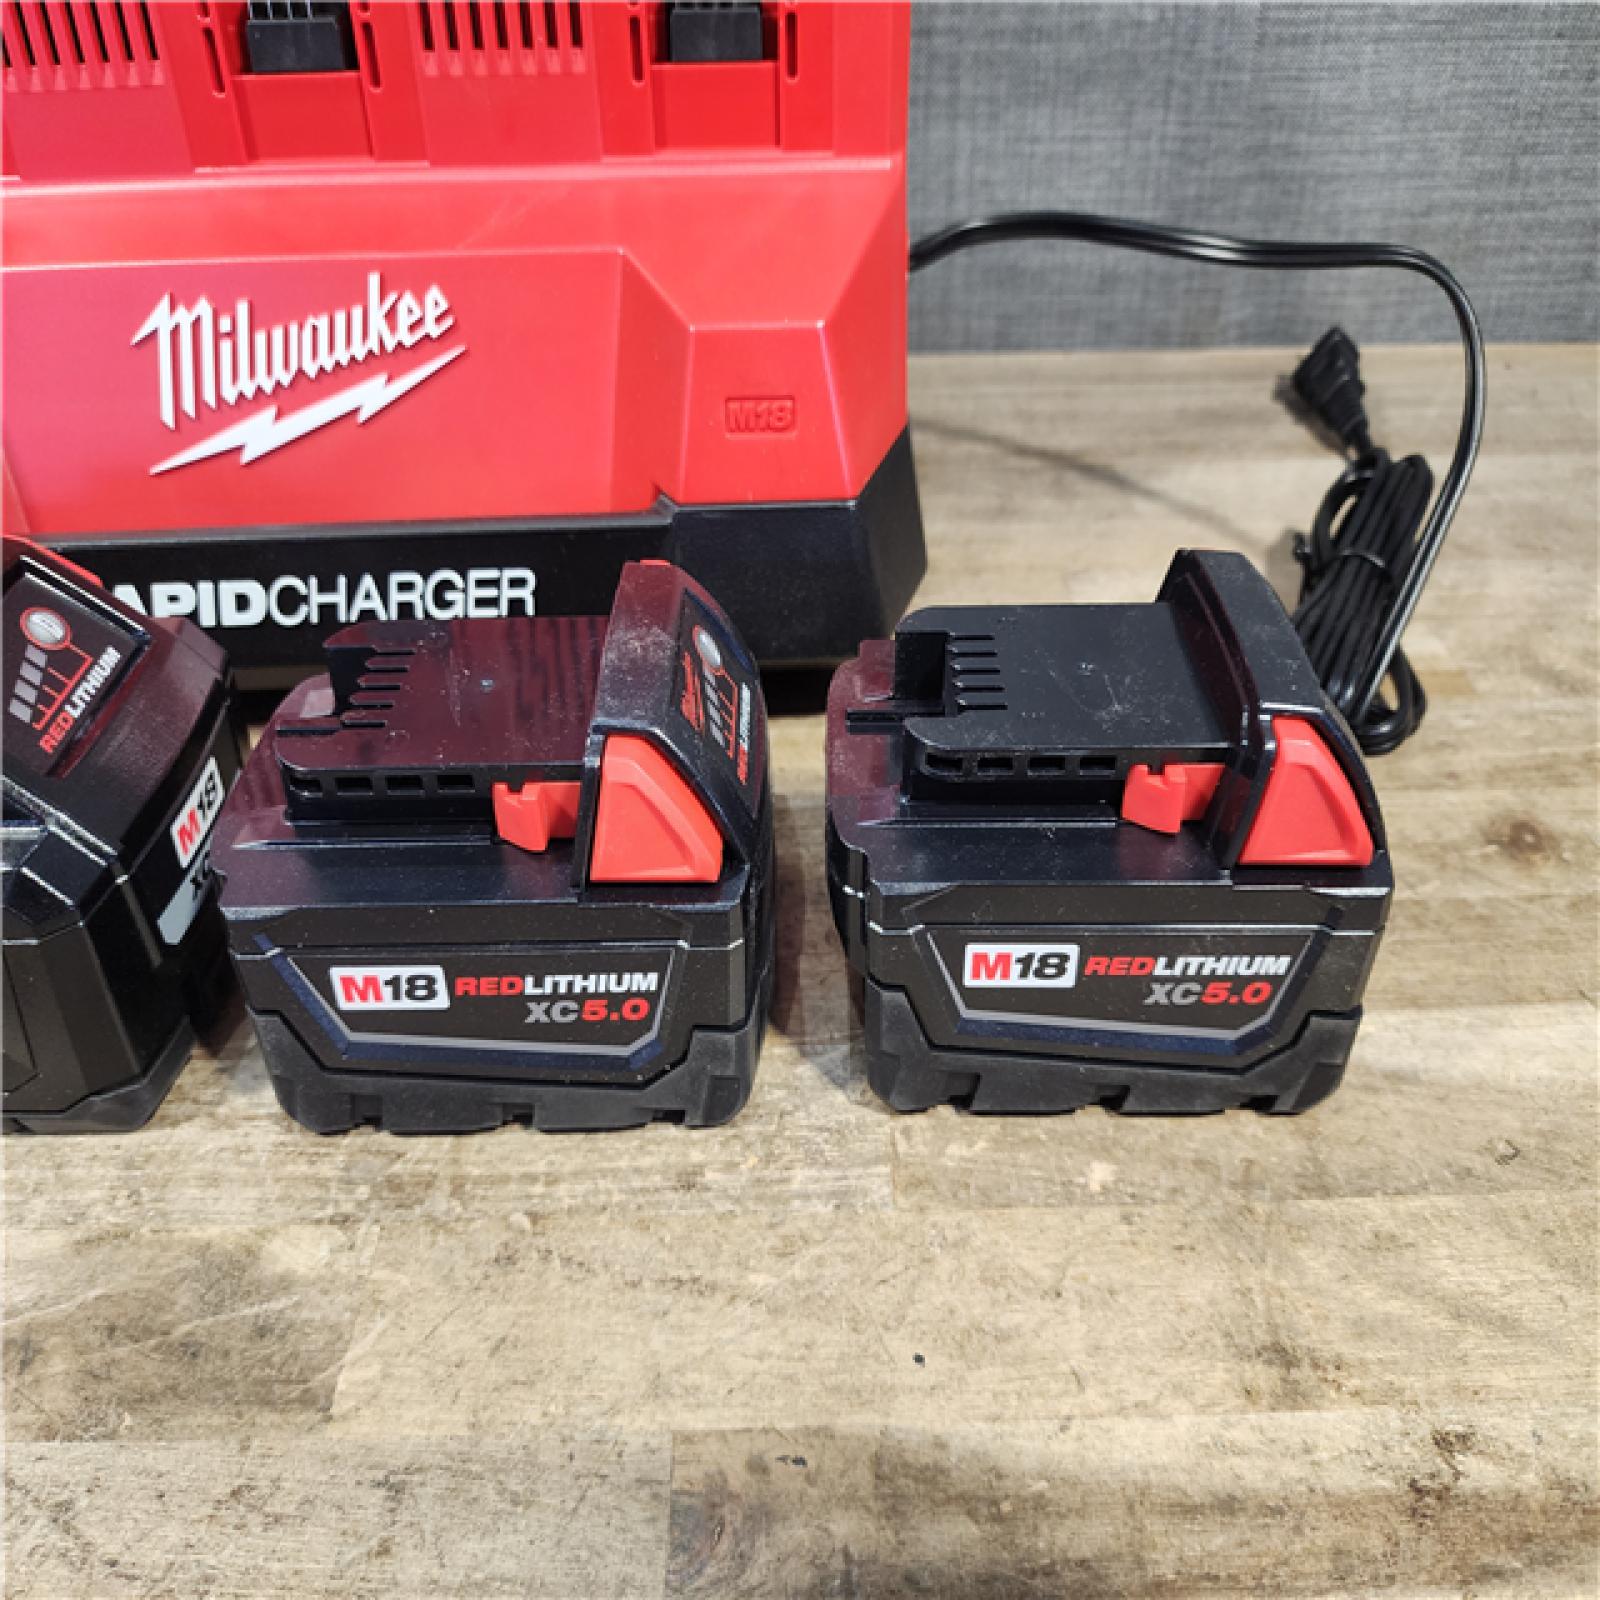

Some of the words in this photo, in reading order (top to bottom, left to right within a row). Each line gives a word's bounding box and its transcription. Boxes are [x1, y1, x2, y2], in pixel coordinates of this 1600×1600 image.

[131, 271, 456, 431] Milwaukee
[727, 401, 792, 432] M18
[112, 567, 536, 628] APIDCHARGER
[177, 769, 217, 856] M18
[970, 952, 1070, 980] M18
[1083, 955, 1291, 977] REDLITHIUM
[339, 974, 439, 1003] M18
[454, 971, 659, 997] REDLITHIUM
[1143, 981, 1274, 1006] XC5.0
[524, 997, 650, 1024] XC5.0
